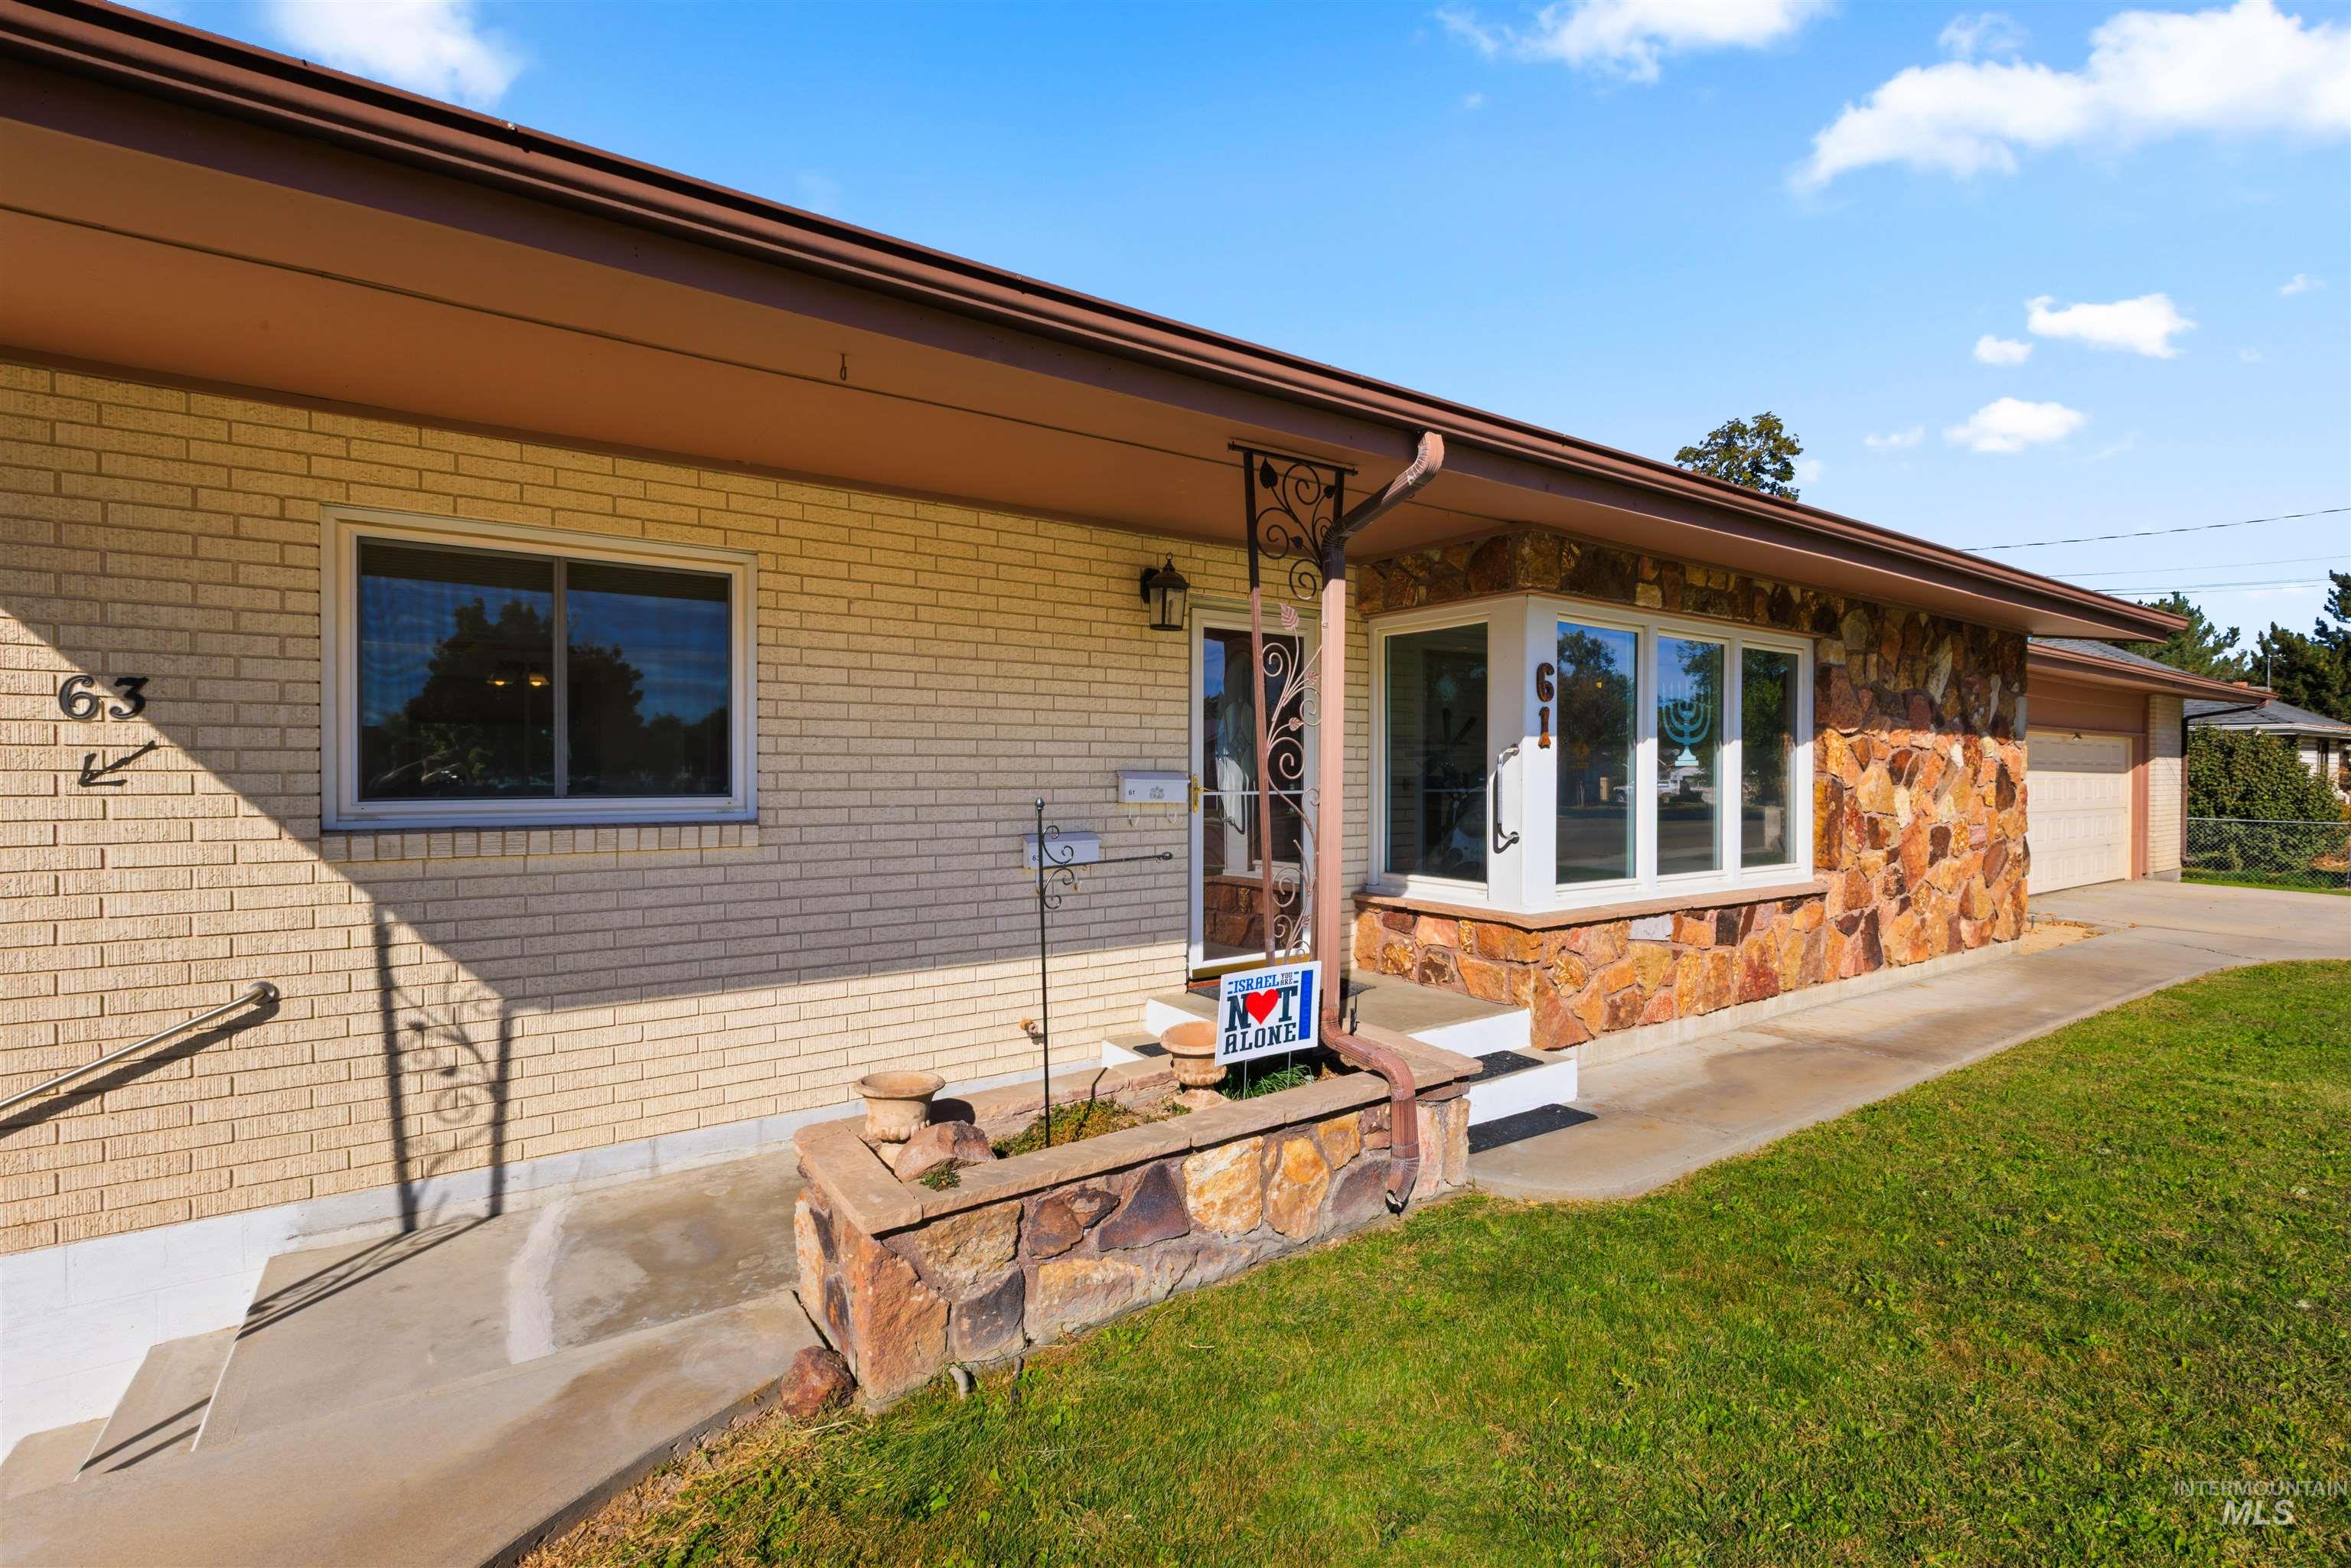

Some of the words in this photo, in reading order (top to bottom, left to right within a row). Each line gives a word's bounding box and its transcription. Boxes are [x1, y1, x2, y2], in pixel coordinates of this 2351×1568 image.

[59, 674, 150, 719] 63
[1536, 662, 1555, 749] 61
[1233, 974, 1280, 993] ISRAEL
[1224, 985, 1298, 1033] NT
[1223, 1022, 1296, 1055] ALONE
